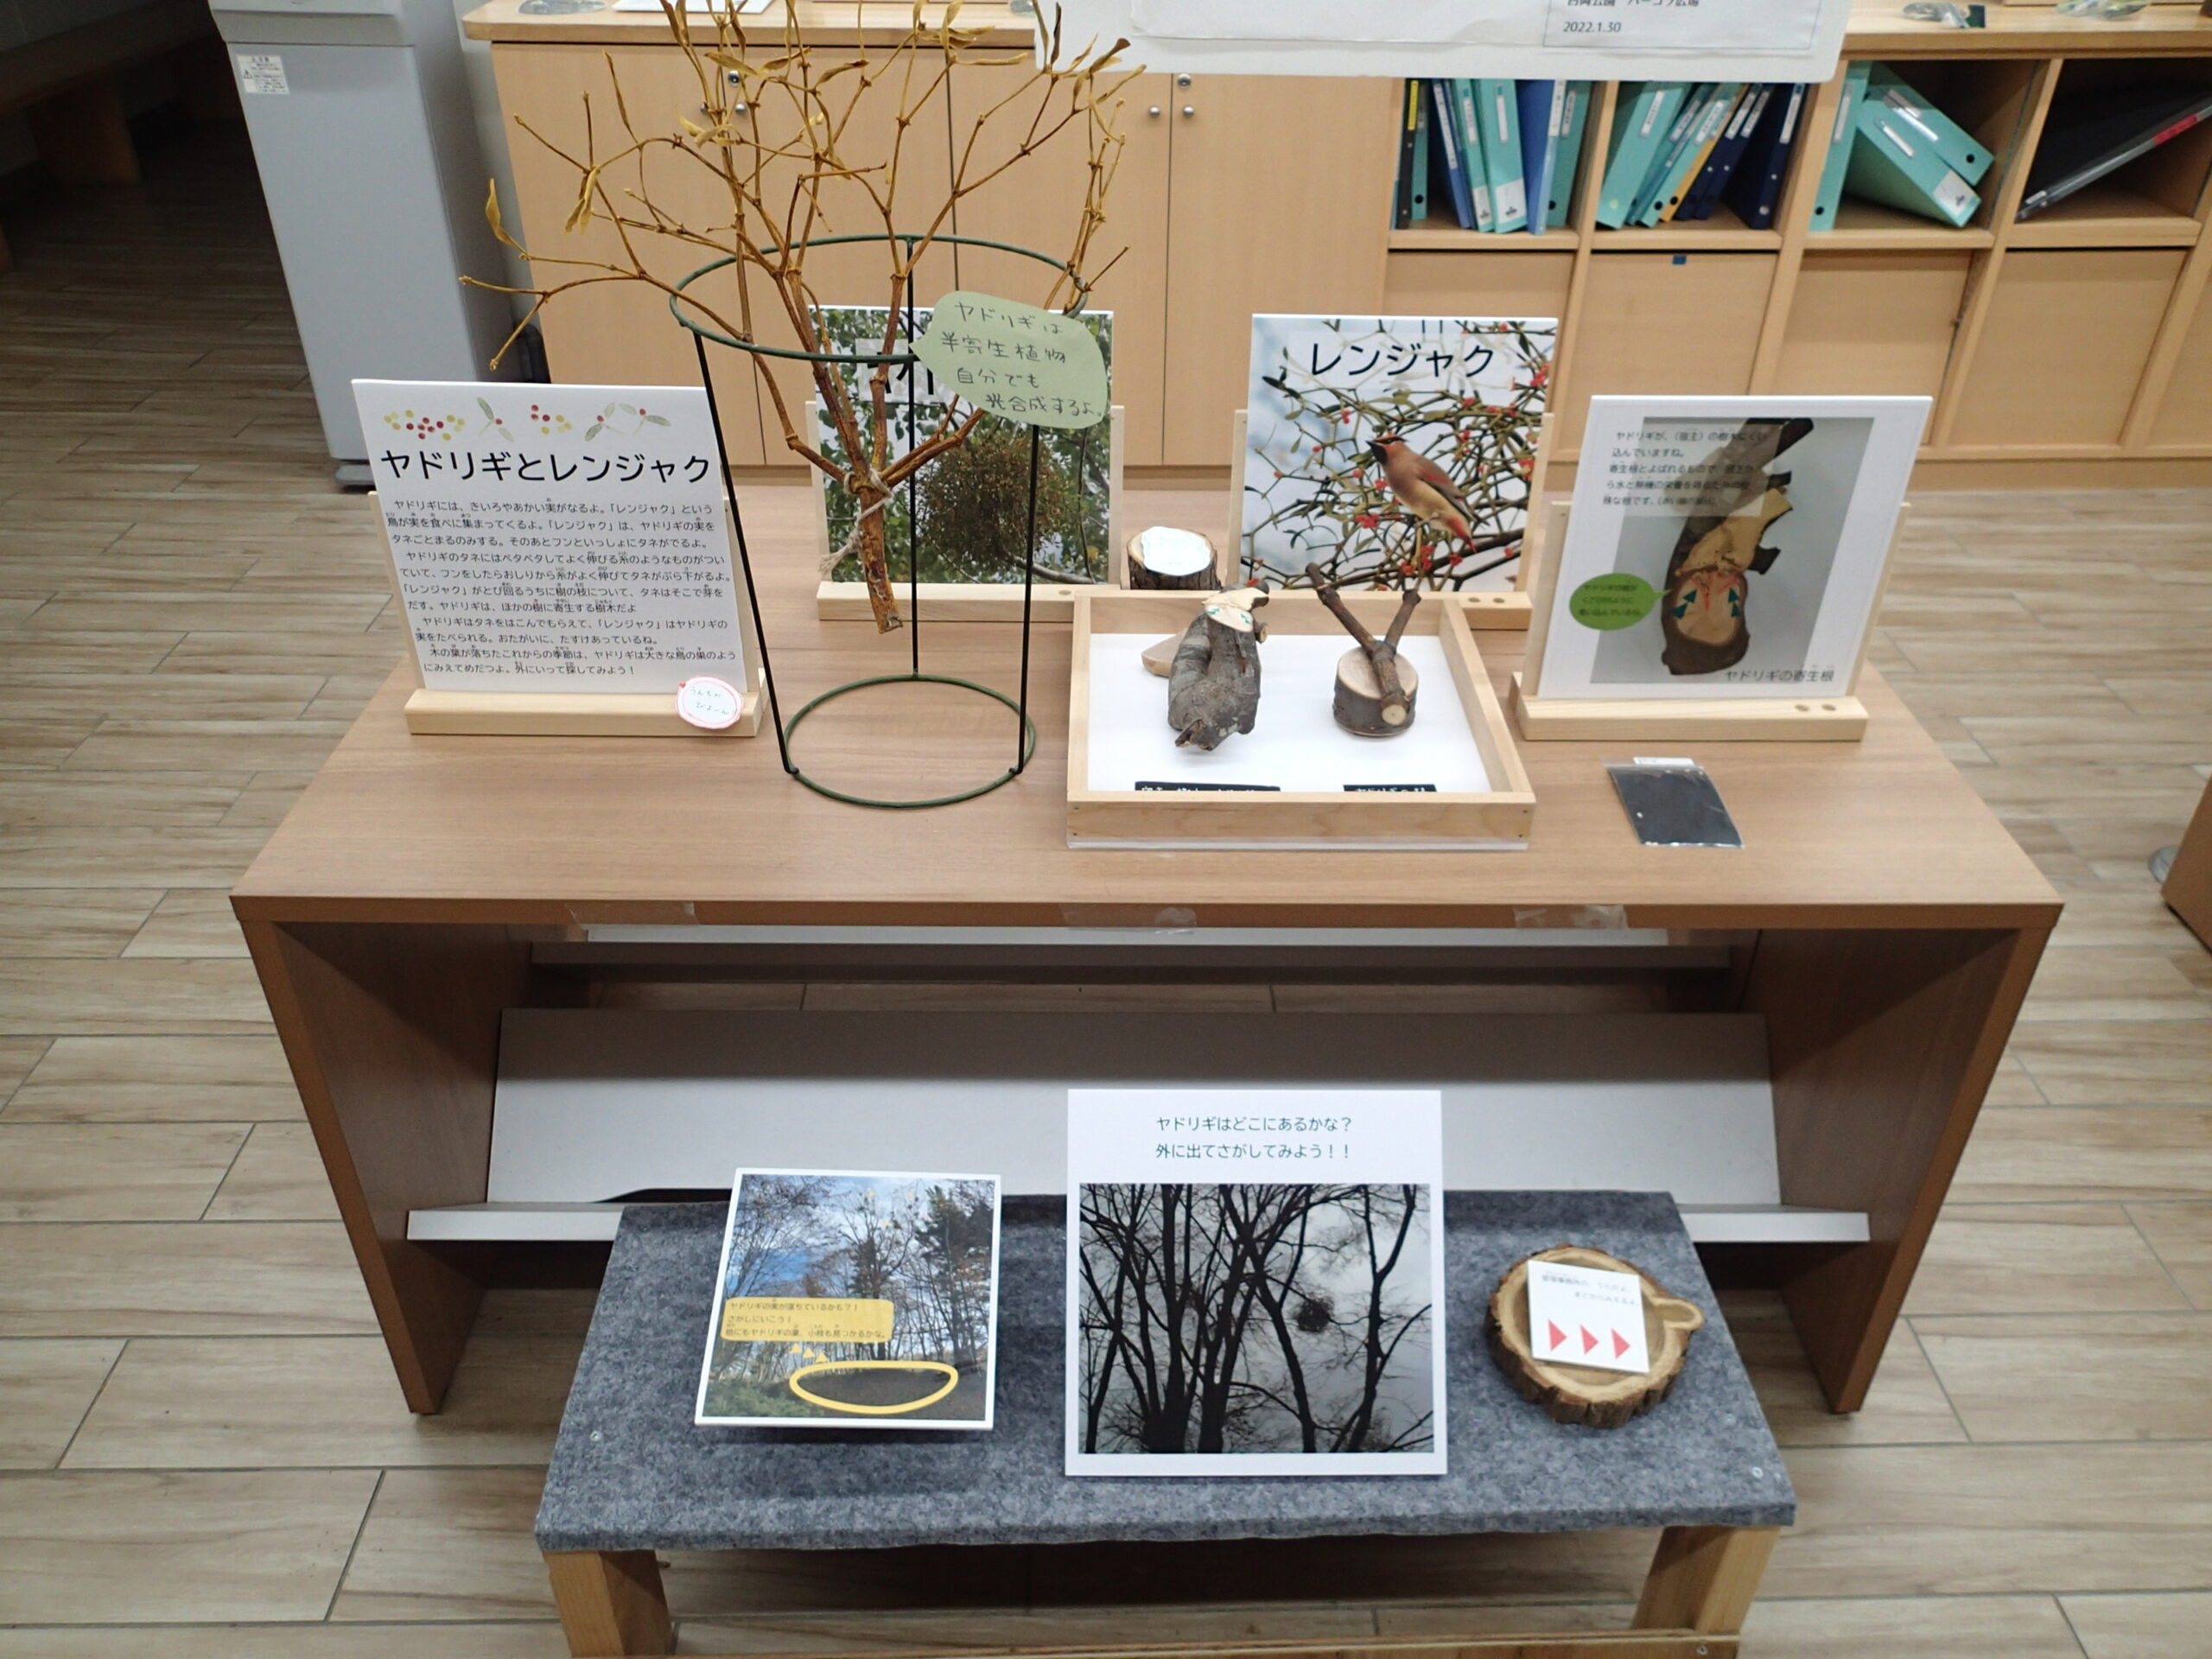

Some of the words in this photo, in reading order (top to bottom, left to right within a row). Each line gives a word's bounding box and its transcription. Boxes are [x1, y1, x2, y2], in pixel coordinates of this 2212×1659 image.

[1562, 21, 1622, 33] 2022.1.30
[954, 301, 1064, 334] ヤドリギは
[940, 333, 1066, 363] 半寄生植物
[1311, 342, 1494, 378] レンジャク
[957, 366, 1040, 389] 自分でも
[985, 393, 1103, 417] 光合成するよ。
[381, 449, 710, 484] ヤドリギとレンジャク
[394, 500, 713, 514] ヤドリギには、きいろやあかい実がなるよ。「レンジャク」という
[387, 518, 715, 532] 鳥が実を食べに集まってくるよ。「レンジャク」は、ヤドリギの実を
[391, 535, 708, 549] タネごとまるのみする。そのあとフンといっしょにタネがでるよ。
[400, 568, 731, 582] ていて、フンをしたらおしりから糸がよく伸びてタネがぶら下がるよ。
[423, 617, 728, 629] ヤドリギはタネをはこんでもらえて、「レンジャク」はヤドリギの
[416, 632, 658, 645] 実をたべられる。おたがいに、たすけあっているね。
[1156, 1116, 1352, 1134] ヤドリギはどこにあるかな？
[1155, 1143, 1351, 1160] 外に出てさがしてみよう！！
